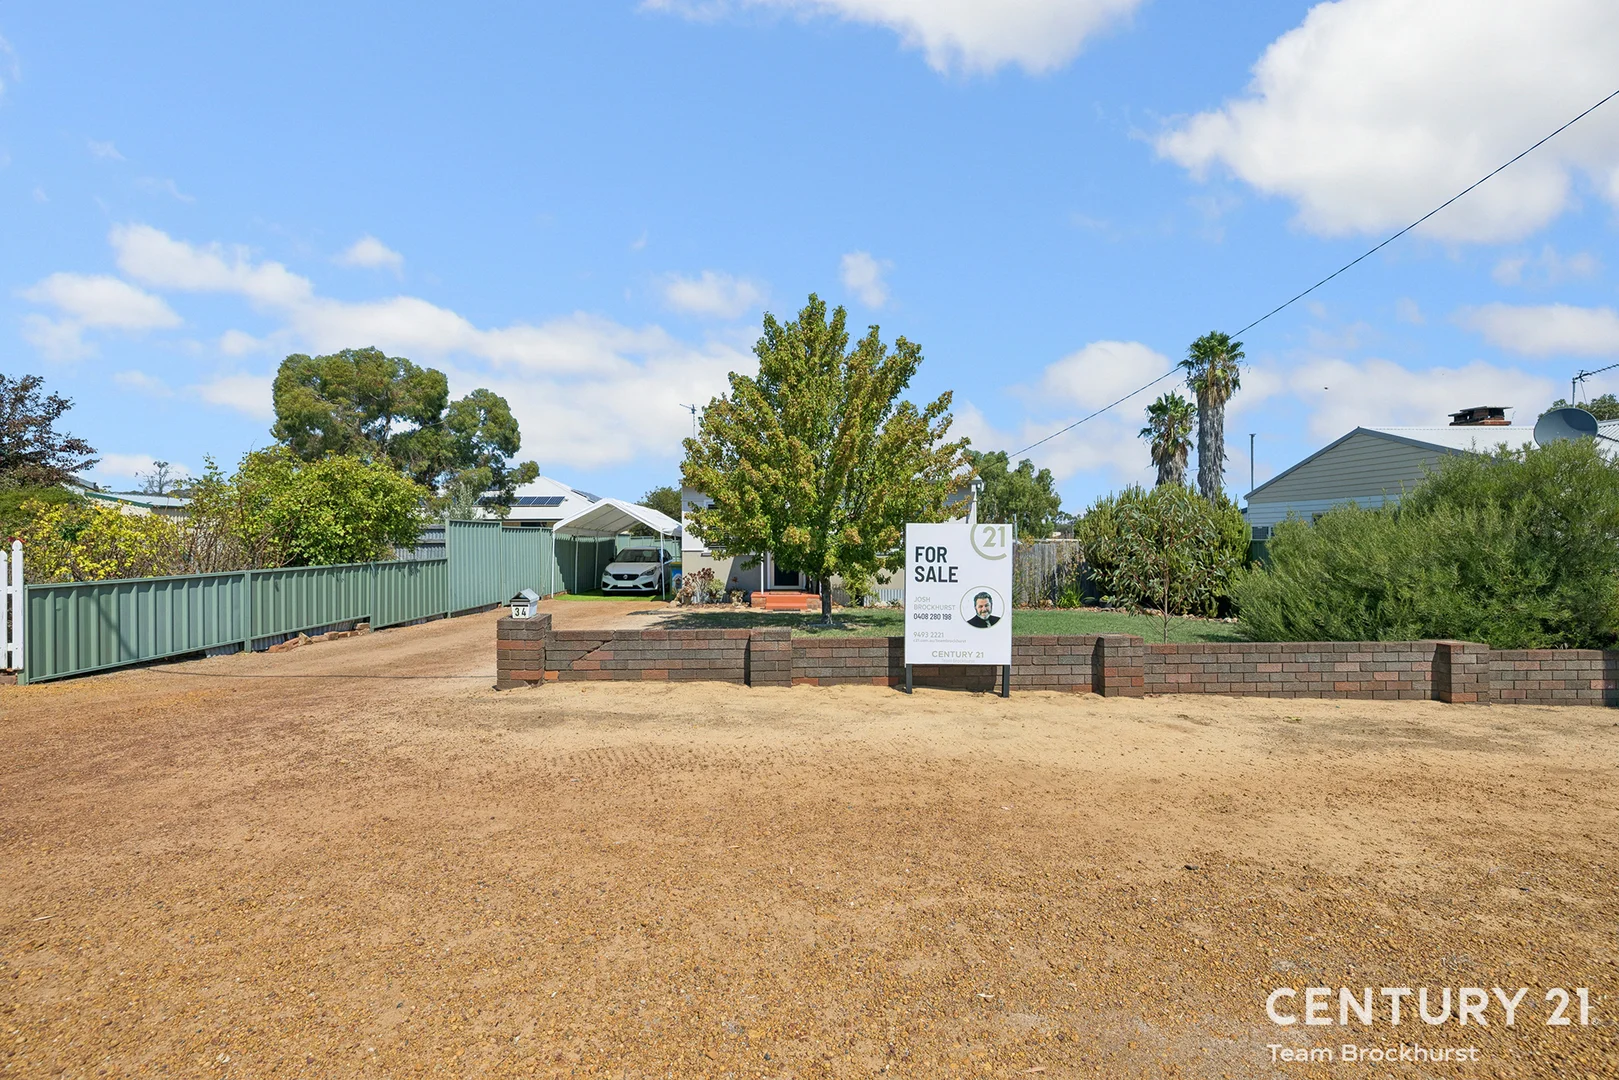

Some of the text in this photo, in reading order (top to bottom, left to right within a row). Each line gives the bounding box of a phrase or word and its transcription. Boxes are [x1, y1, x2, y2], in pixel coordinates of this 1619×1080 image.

[915, 546, 948, 563] FOR
[914, 566, 959, 583] SALE
[929, 613, 941, 621] 280
[930, 631, 944, 639] 2221
[931, 650, 985, 659] CENTURY 21
